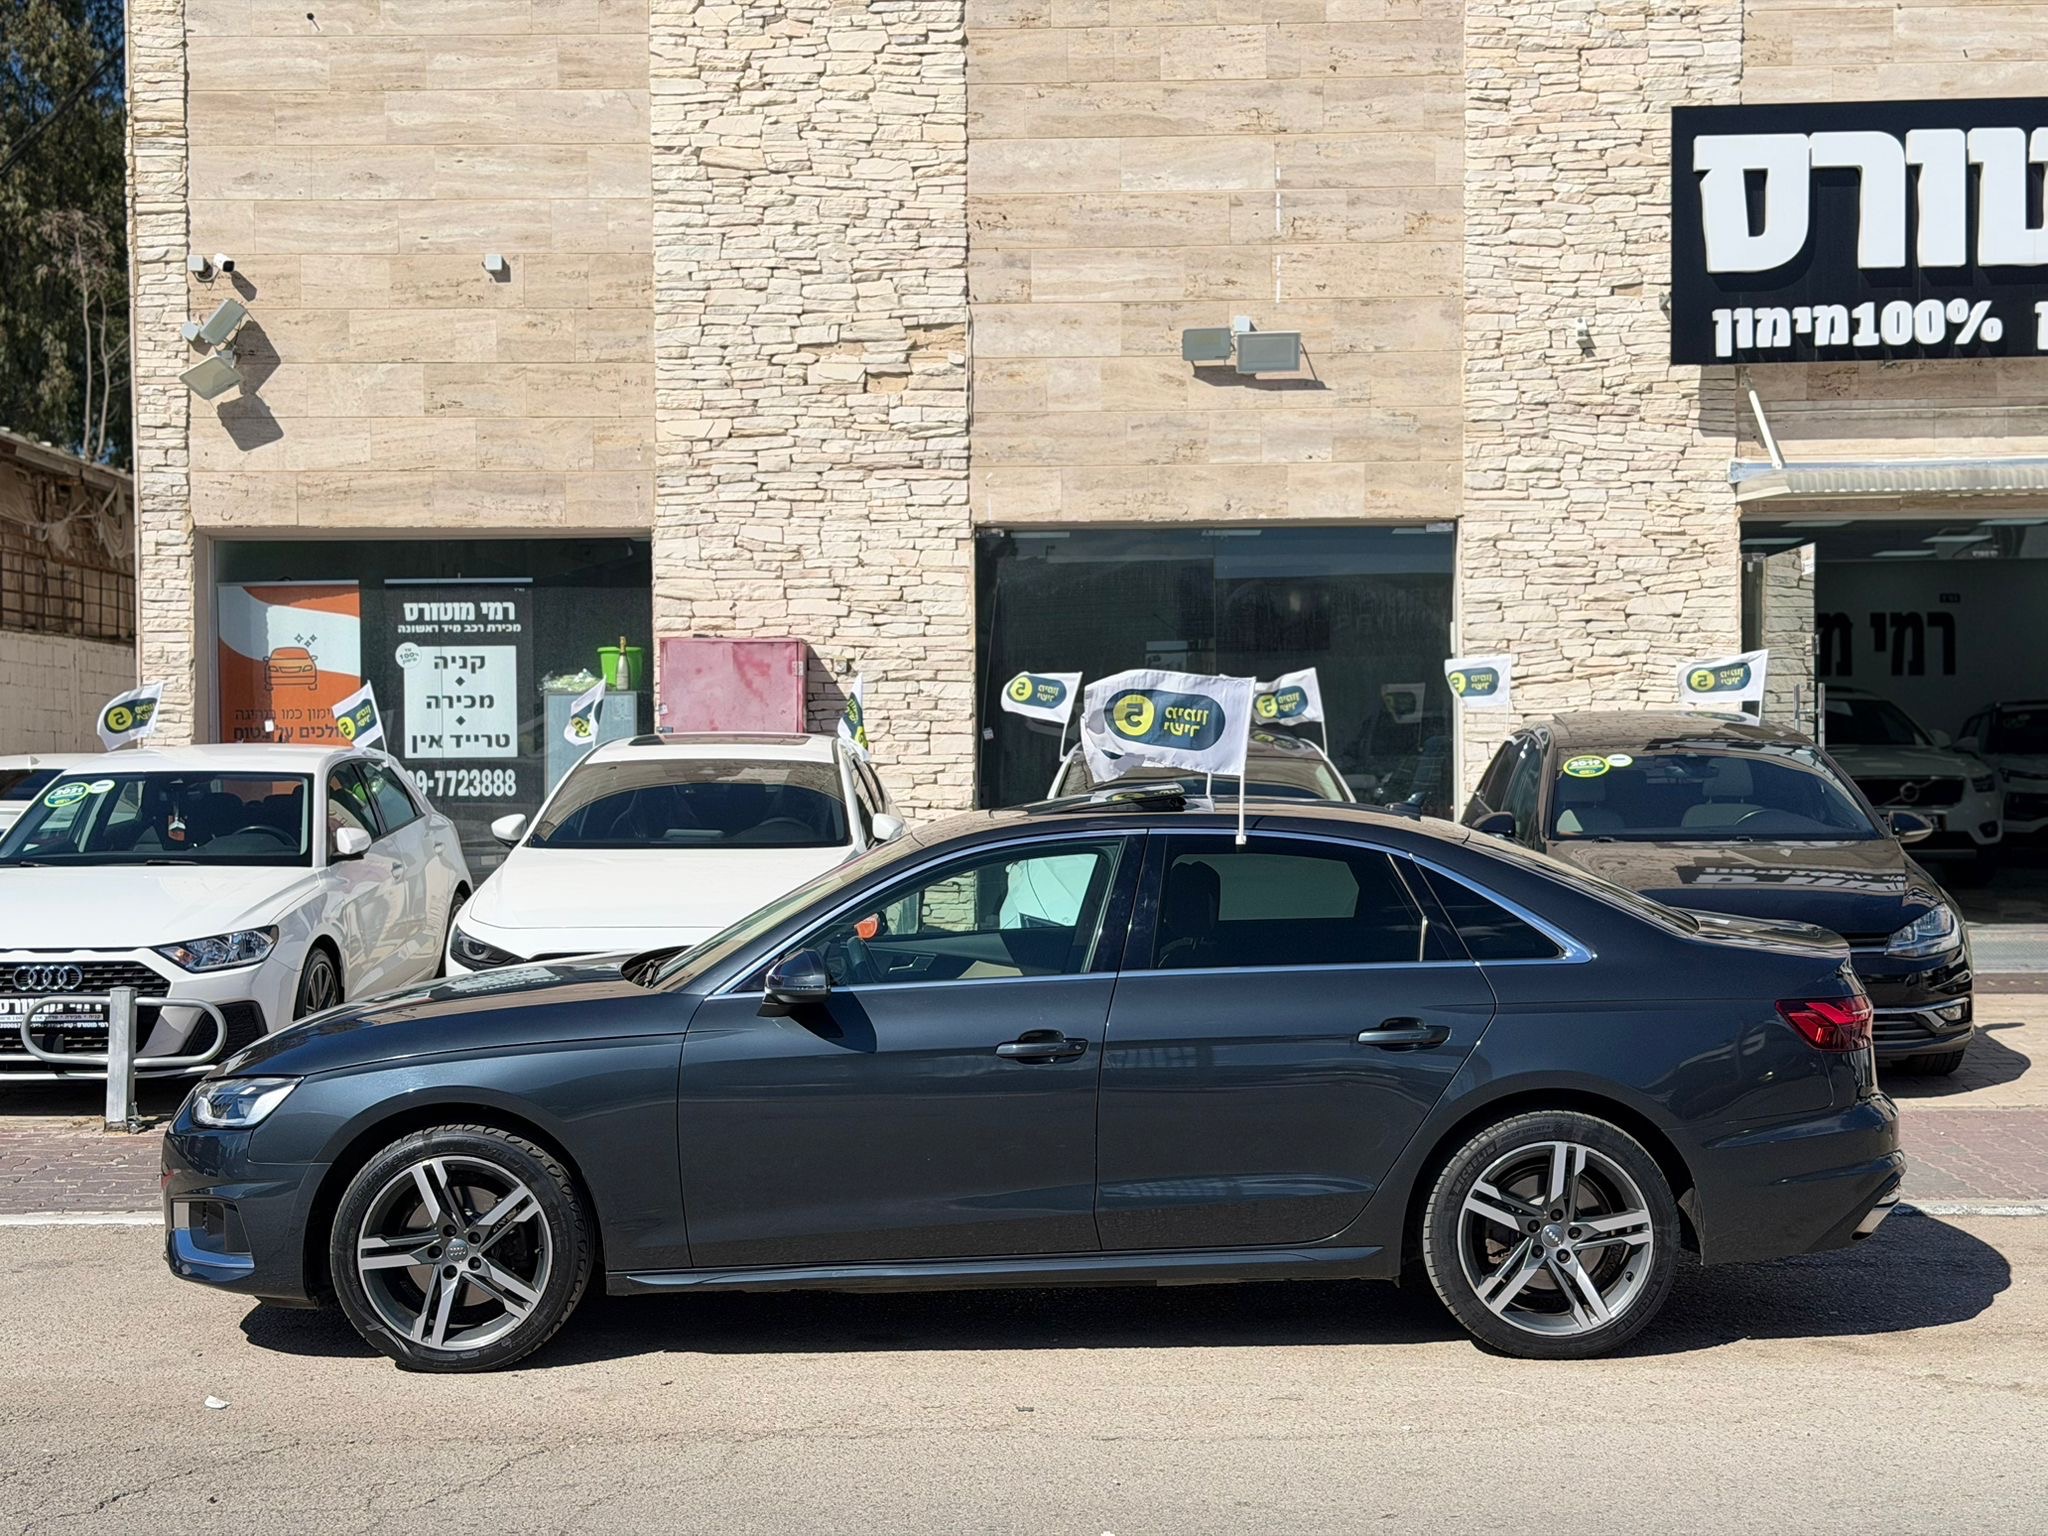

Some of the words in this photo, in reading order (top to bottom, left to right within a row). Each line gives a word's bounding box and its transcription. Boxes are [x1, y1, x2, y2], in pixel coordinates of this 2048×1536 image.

[403, 602, 475, 621] מוטורס
[480, 602, 515, 620] רמי
[397, 625, 439, 633] ראשונה
[441, 624, 461, 632] מיד
[463, 624, 484, 632] רכב
[486, 624, 521, 633] מכירת
[1870, 611, 1956, 676] רמי
[434, 655, 486, 674] קניה
[426, 694, 494, 709] מכירה
[281, 709, 303, 719] כמו
[307, 708, 334, 721] ימון
[412, 734, 443, 754] אין
[450, 733, 511, 748] טרייד
